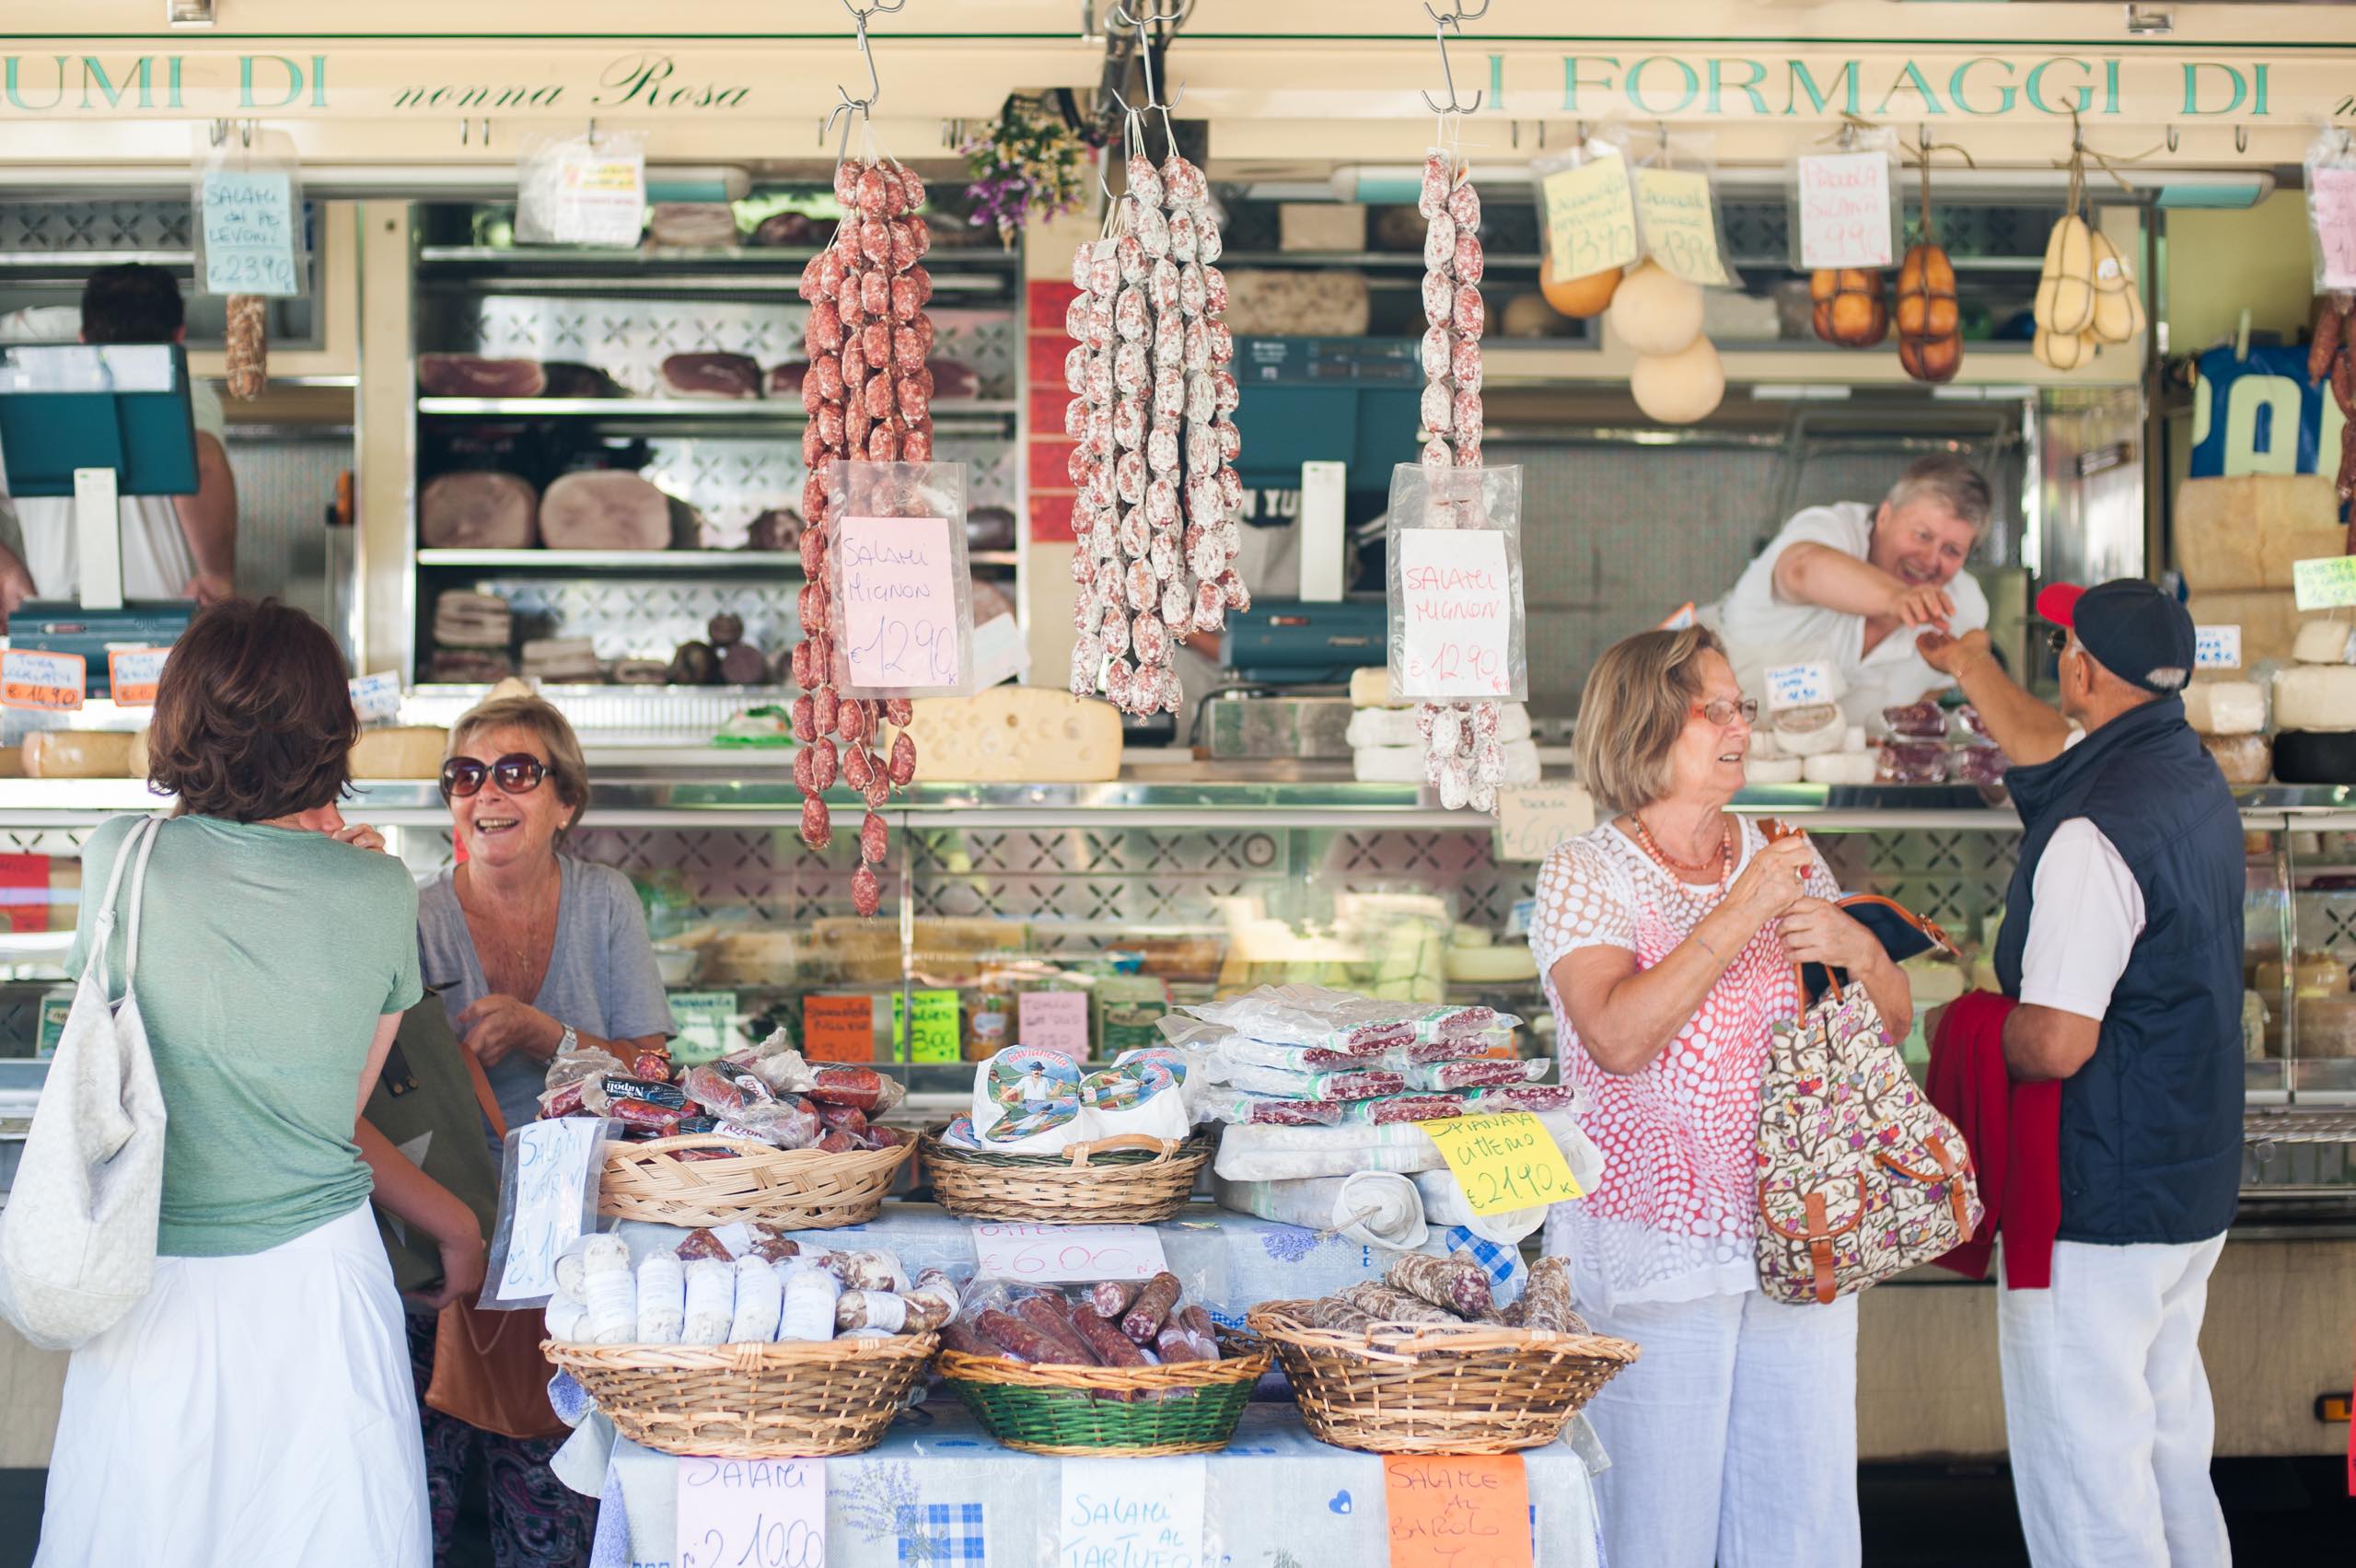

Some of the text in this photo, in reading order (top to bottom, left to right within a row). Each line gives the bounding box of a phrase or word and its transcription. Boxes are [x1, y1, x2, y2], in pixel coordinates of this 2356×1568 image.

[238, 55, 329, 108] DI
[392, 51, 752, 110] nonna Rosa
[1485, 53, 2271, 116] I FORMAGGI DI
[1157, 1527, 1185, 1548] AL
